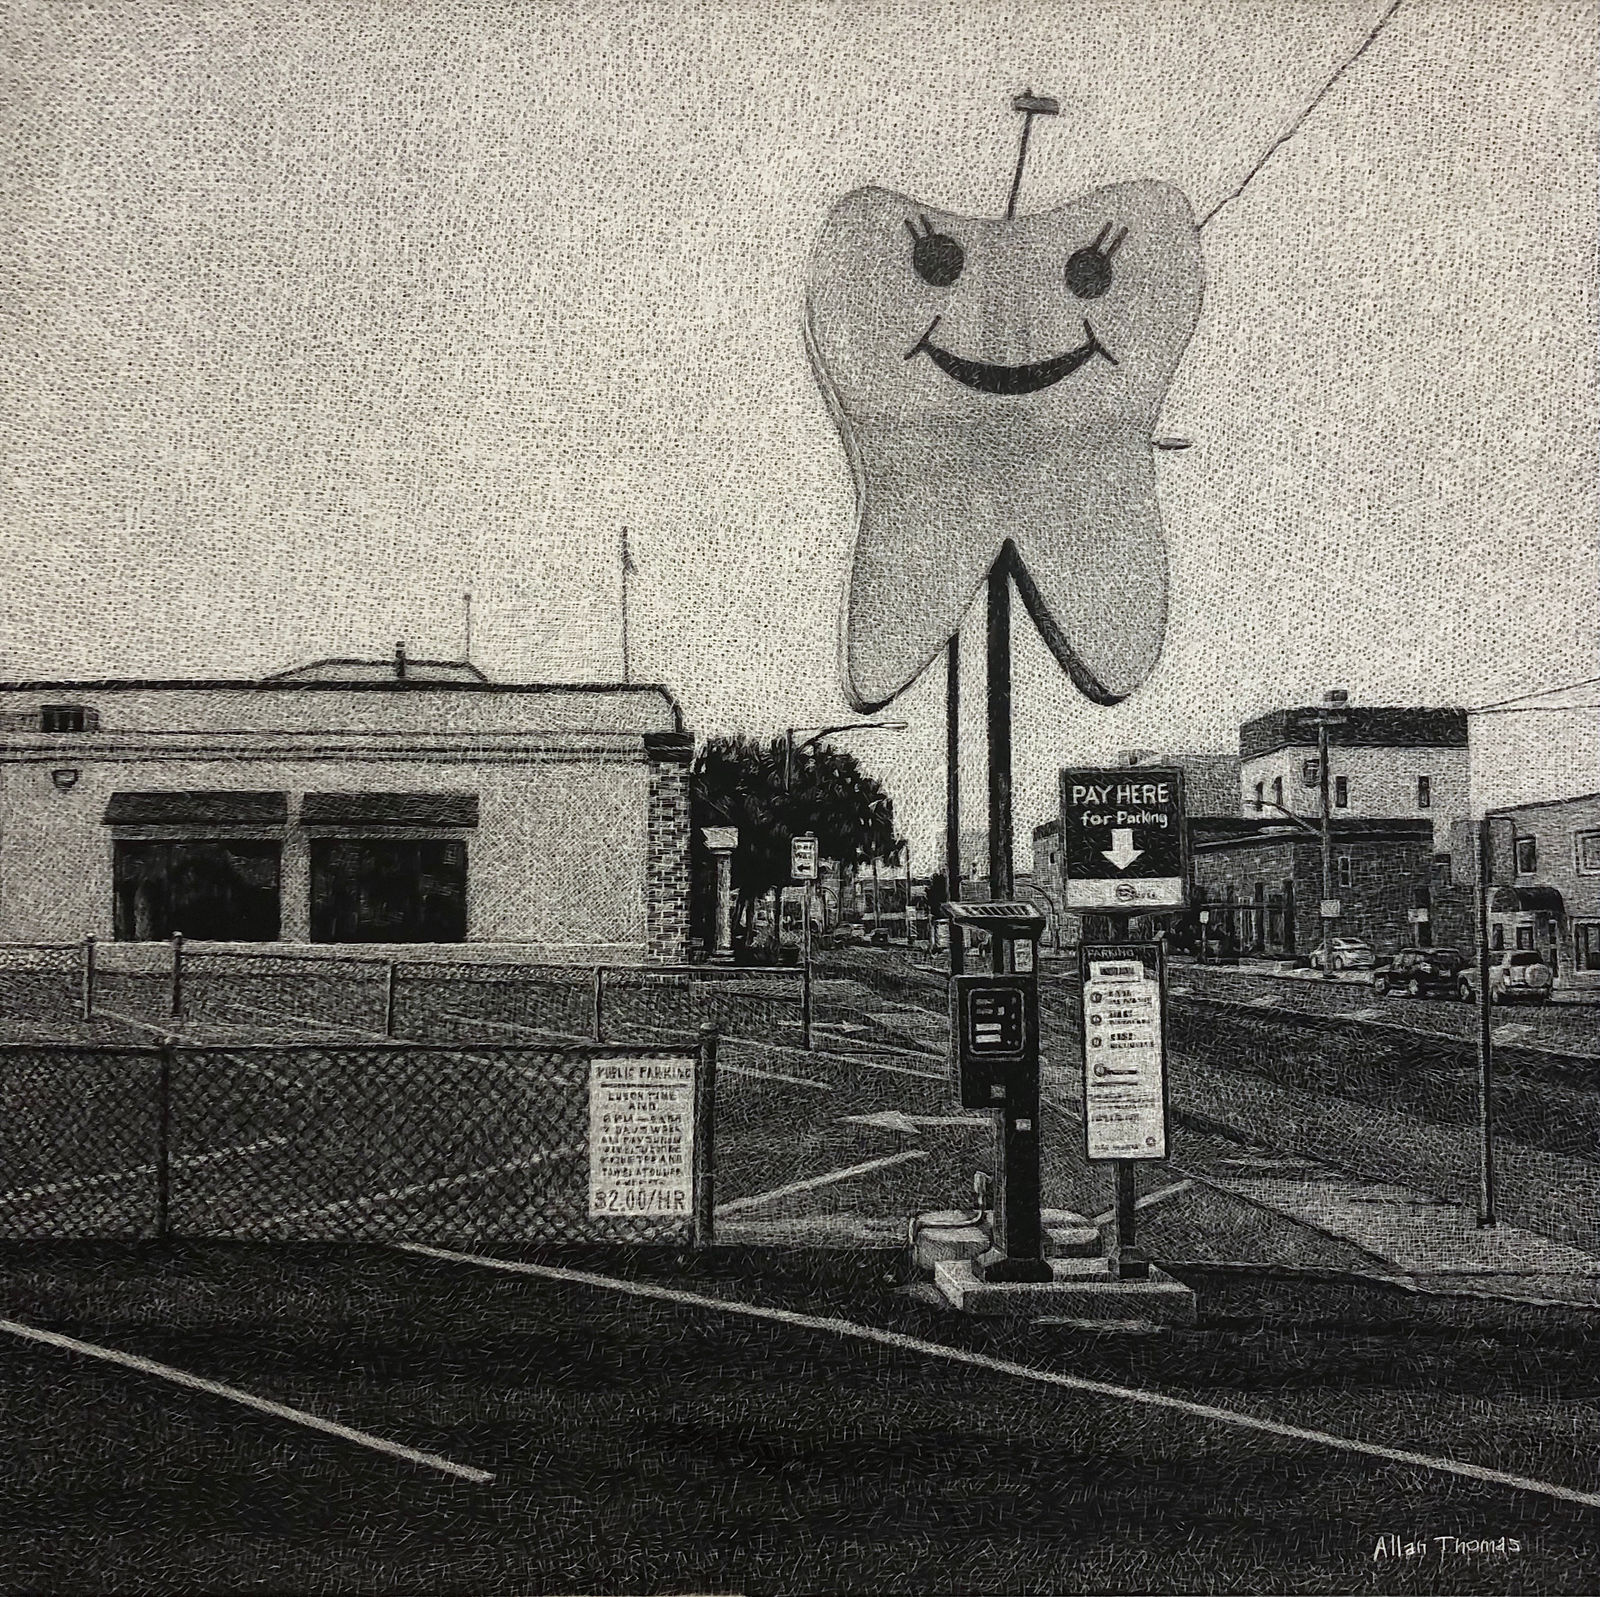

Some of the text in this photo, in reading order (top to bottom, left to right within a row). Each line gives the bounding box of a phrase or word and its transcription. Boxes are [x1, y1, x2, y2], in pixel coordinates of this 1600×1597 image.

[1072, 782, 1169, 805] PAY HERE
[1080, 809, 1168, 829] for Parking
[597, 1066, 691, 1080] PUBLIC PARKING
[1373, 1534, 1521, 1562] Allan Thomas
